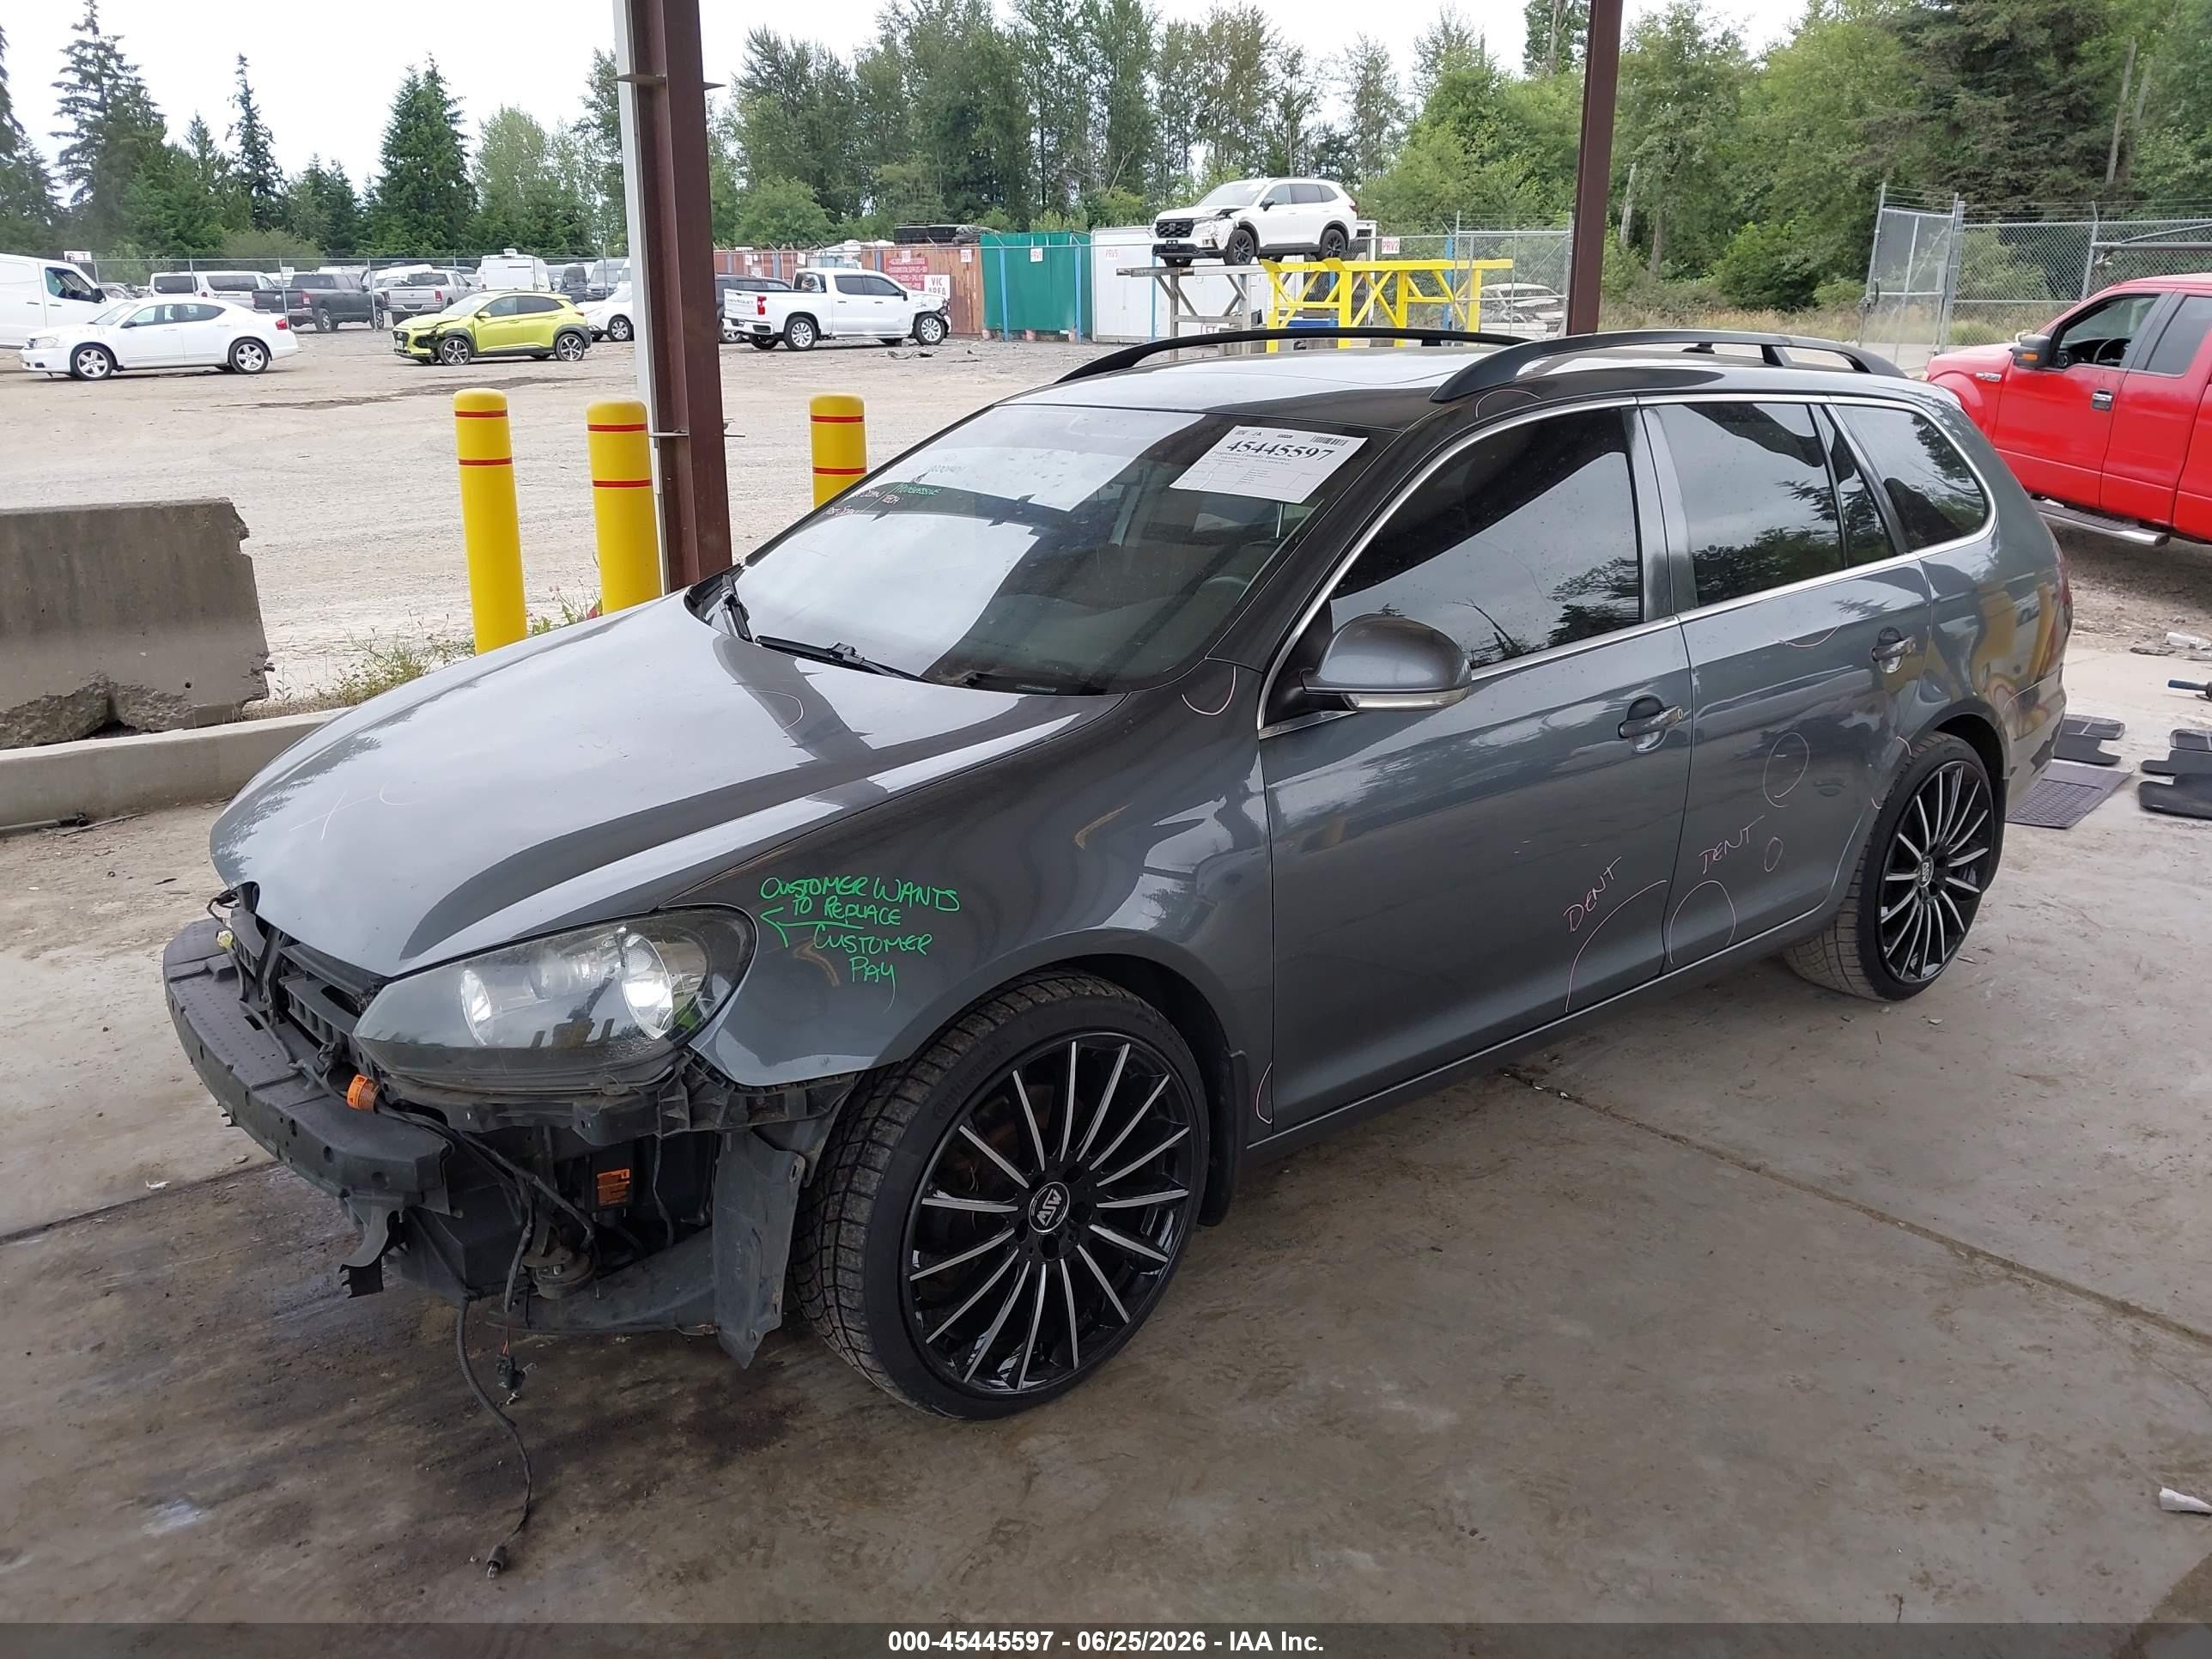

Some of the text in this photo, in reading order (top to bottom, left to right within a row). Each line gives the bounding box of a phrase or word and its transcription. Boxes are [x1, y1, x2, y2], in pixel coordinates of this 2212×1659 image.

[1382, 240, 1400, 252] PRV2
[931, 276, 943, 286] VIC
[1226, 440, 1335, 461] 45445597
[872, 877, 960, 912] WANTS
[1563, 856, 1622, 933] DENT
[793, 896, 902, 926] TO REPLACE
[813, 923, 933, 955] CUSTOMER
[848, 956, 896, 1012] PAY
